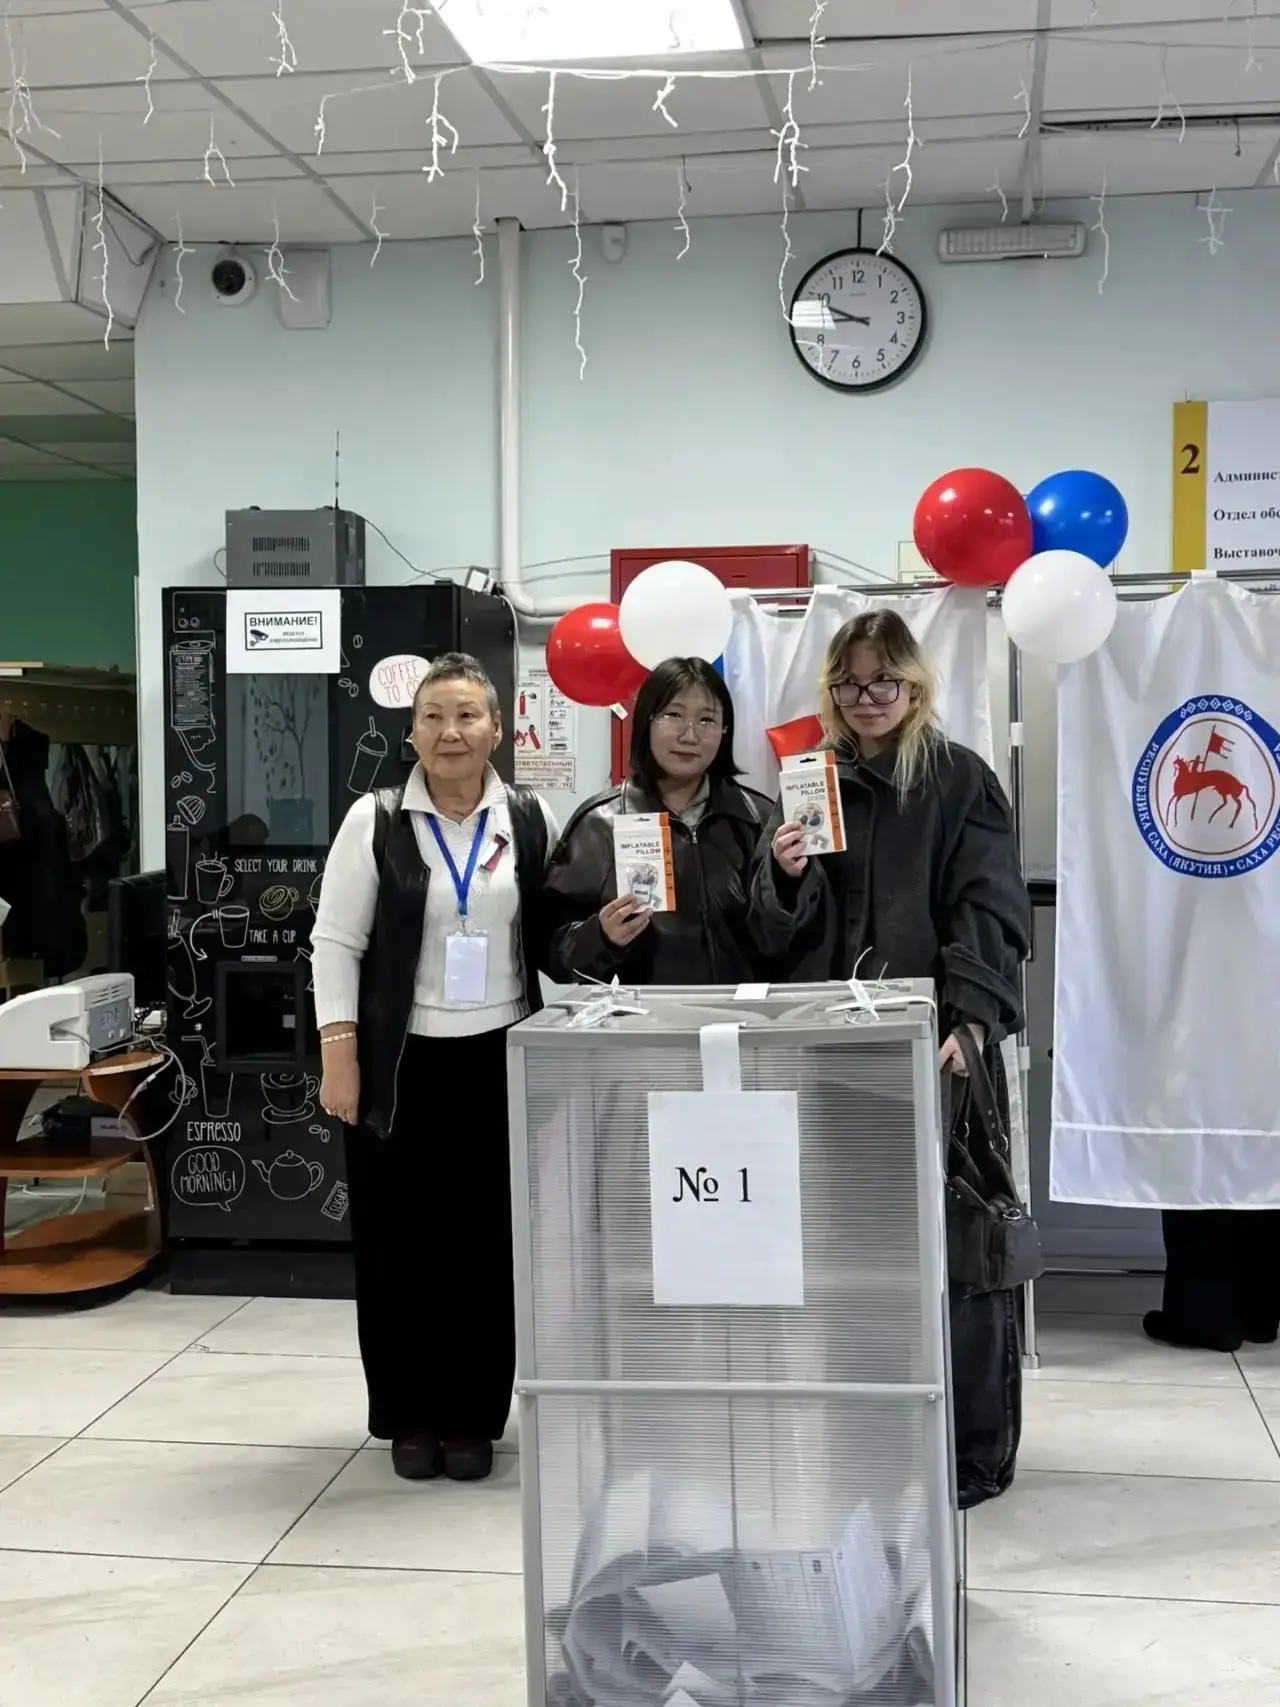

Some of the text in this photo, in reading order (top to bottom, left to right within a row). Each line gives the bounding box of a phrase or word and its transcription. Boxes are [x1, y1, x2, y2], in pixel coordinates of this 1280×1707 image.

[833, 276, 843, 290] 11
[852, 269, 865, 284] 12
[877, 274, 883, 288] 1
[890, 290, 899, 304] 2
[896, 311, 905, 325] 3
[816, 333, 825, 347] 8
[889, 331, 898, 345] 4
[831, 350, 839, 364] 7
[851, 355, 861, 369] 6
[876, 348, 886, 362] 5
[1180, 443, 1200, 474] 2
[1212, 471, 1280, 483] Админис
[1213, 508, 1256, 521] Отдел
[249, 615, 318, 627] ВНИМАНИЕ!
[378, 658, 421, 686] COFFEE
[383, 683, 401, 704] TO
[786, 781, 824, 791] INFLATABLE
[801, 788, 826, 796] PILLOW
[1136, 741, 1228, 876] РЕСПУБЛИКА САХА (ЯКУТИЯ)
[620, 841, 660, 849] INFLATABLE
[234, 858, 317, 873] SELECT YOUR DRINK
[1236, 848, 1268, 870] САХА
[249, 929, 297, 944] TAKE A CUP
[187, 1151, 220, 1175] GOOD
[180, 1170, 236, 1194] MORNING!
[672, 1166, 752, 1203] № 1
